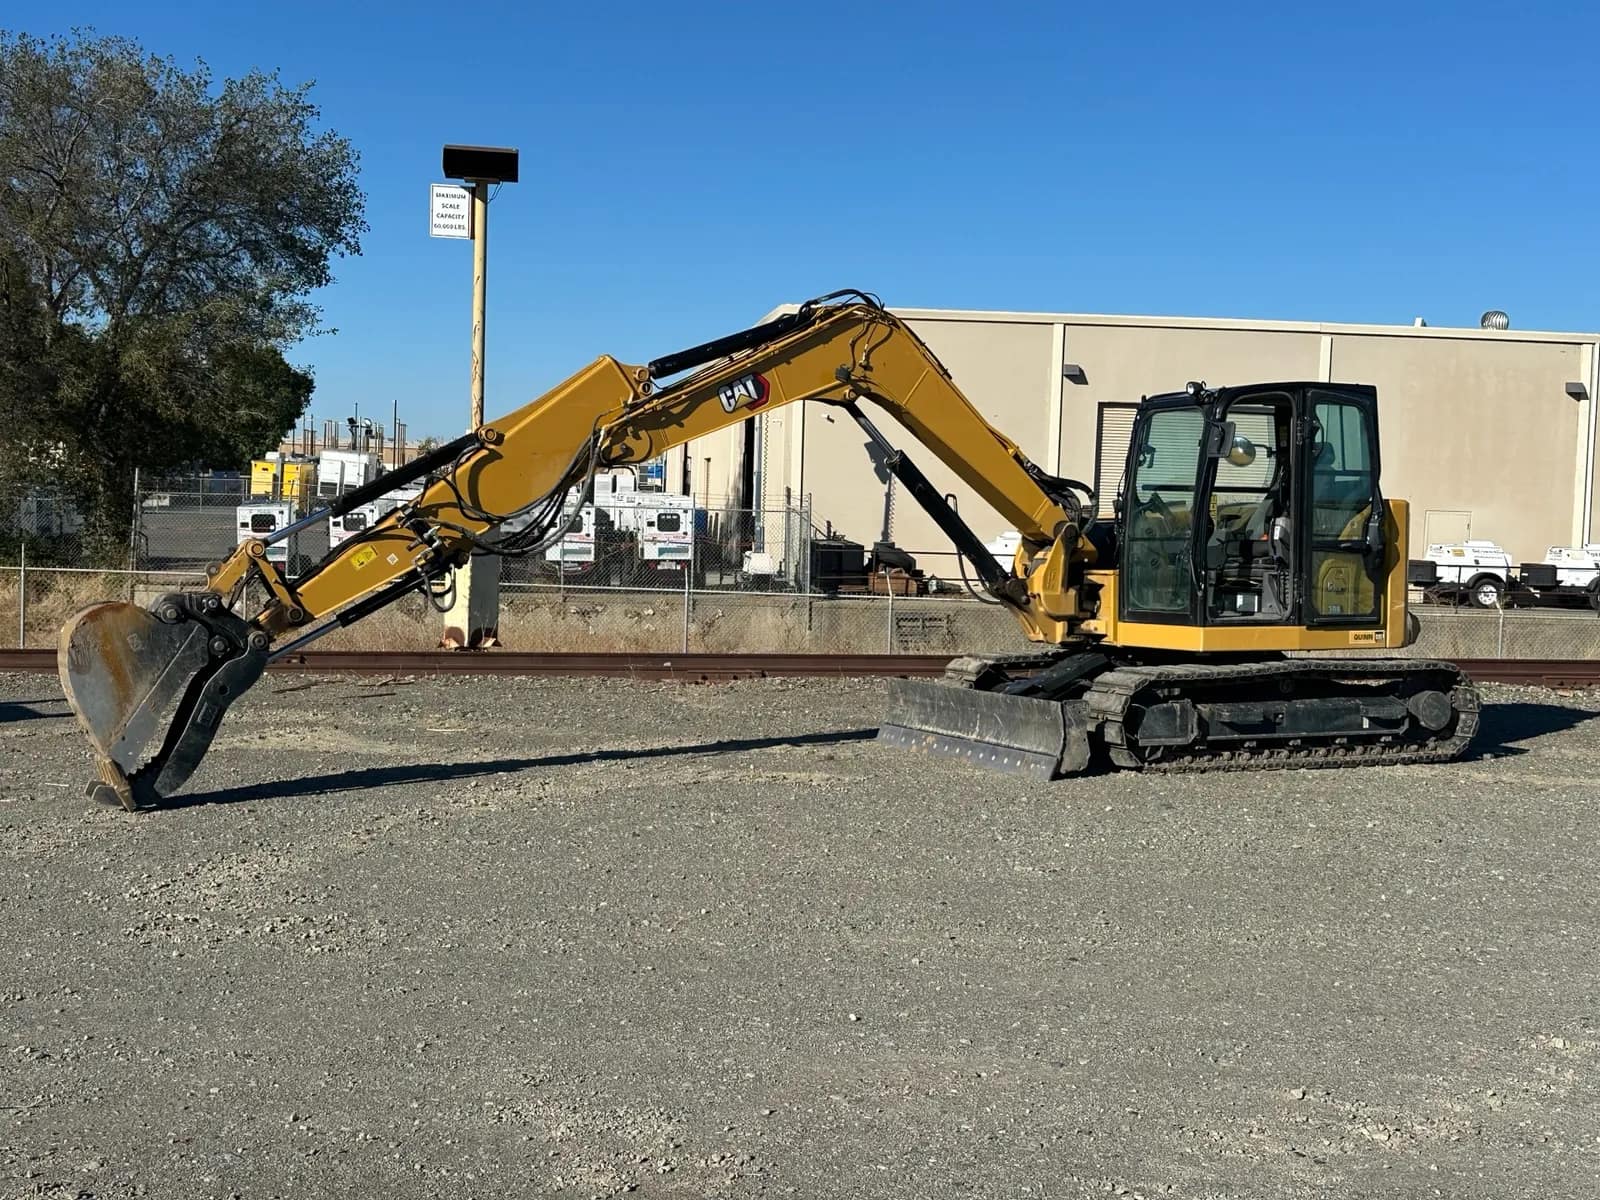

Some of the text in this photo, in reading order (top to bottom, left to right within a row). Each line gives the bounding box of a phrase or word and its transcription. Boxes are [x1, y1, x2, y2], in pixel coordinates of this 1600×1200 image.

[436, 212, 465, 220] CAPACITY
[718, 374, 759, 413] CAT
[1353, 633, 1374, 641] QUINN
